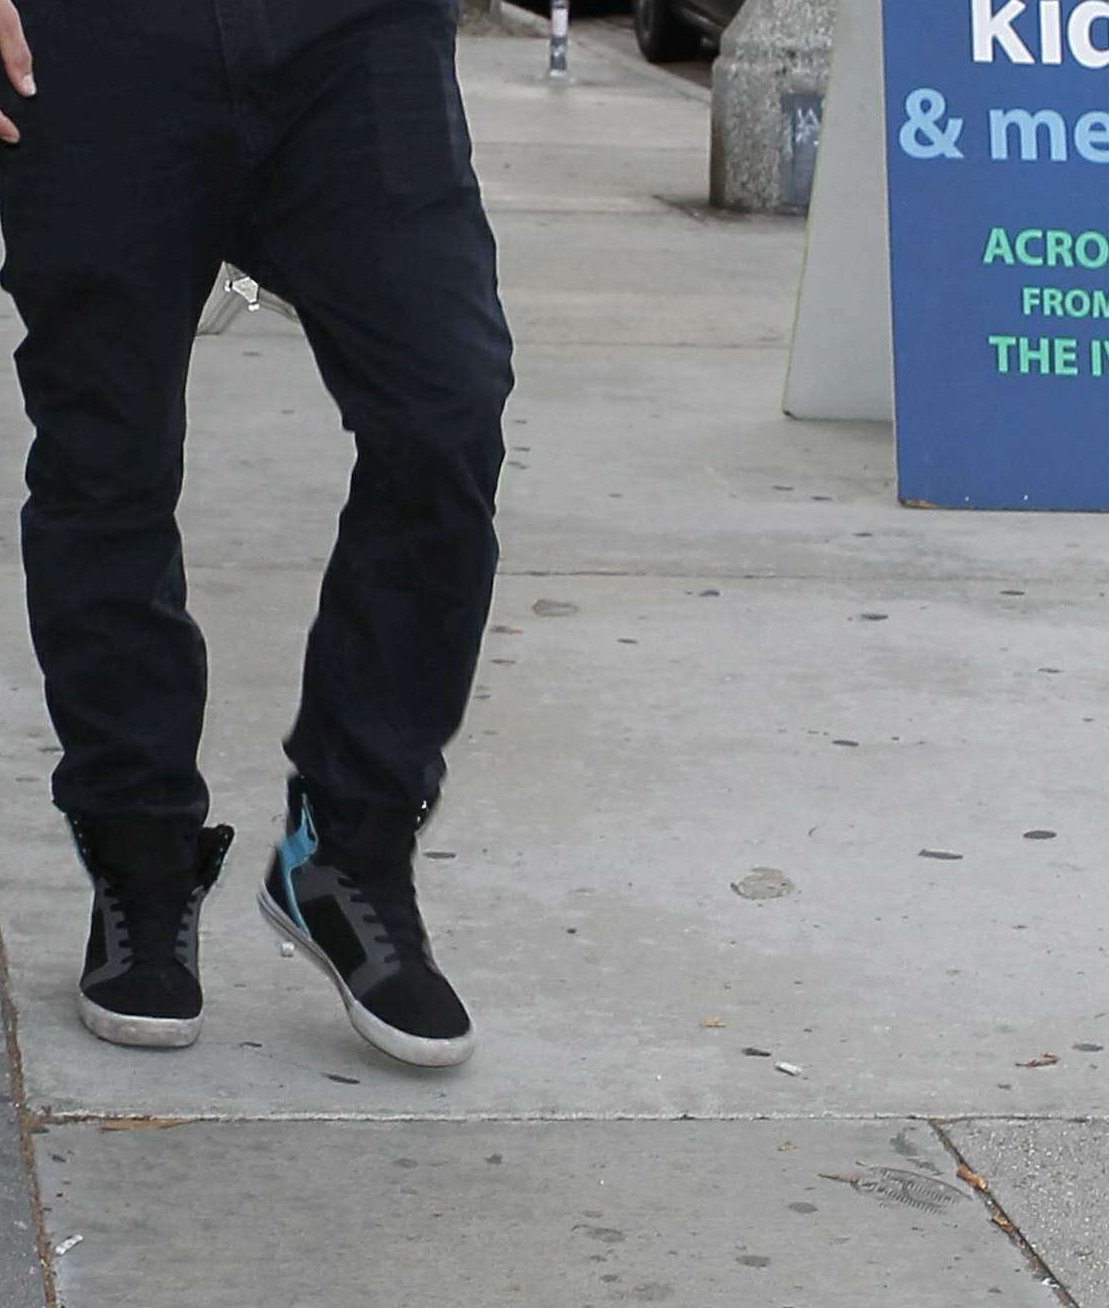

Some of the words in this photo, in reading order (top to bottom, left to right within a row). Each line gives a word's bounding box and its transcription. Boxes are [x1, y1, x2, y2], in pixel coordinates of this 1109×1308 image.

[898, 88, 965, 159] &
[989, 108, 1109, 164] me
[982, 227, 1109, 269] ACRO
[988, 335, 1078, 376] THE
[1091, 339, 1109, 376] I
